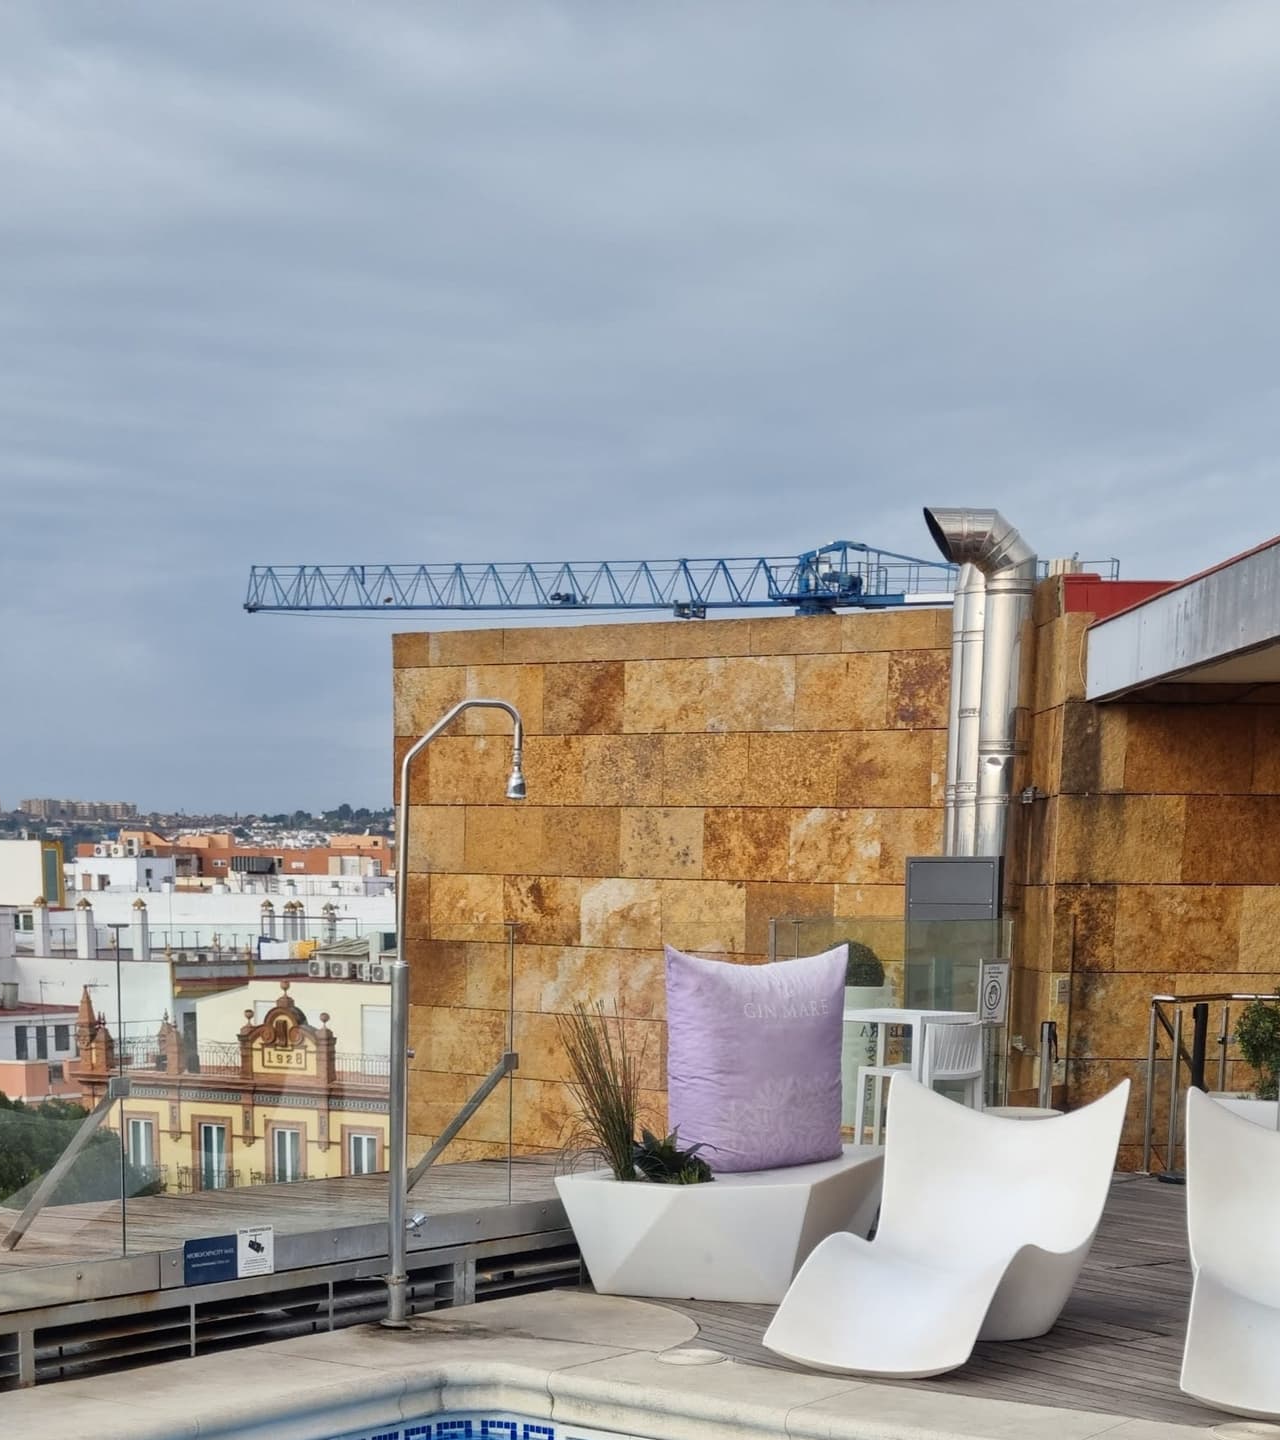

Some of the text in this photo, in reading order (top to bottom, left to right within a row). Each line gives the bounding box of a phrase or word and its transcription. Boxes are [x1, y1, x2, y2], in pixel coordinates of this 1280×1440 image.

[743, 998, 830, 1018] GIN MARE
[267, 1051, 302, 1065] 1928
